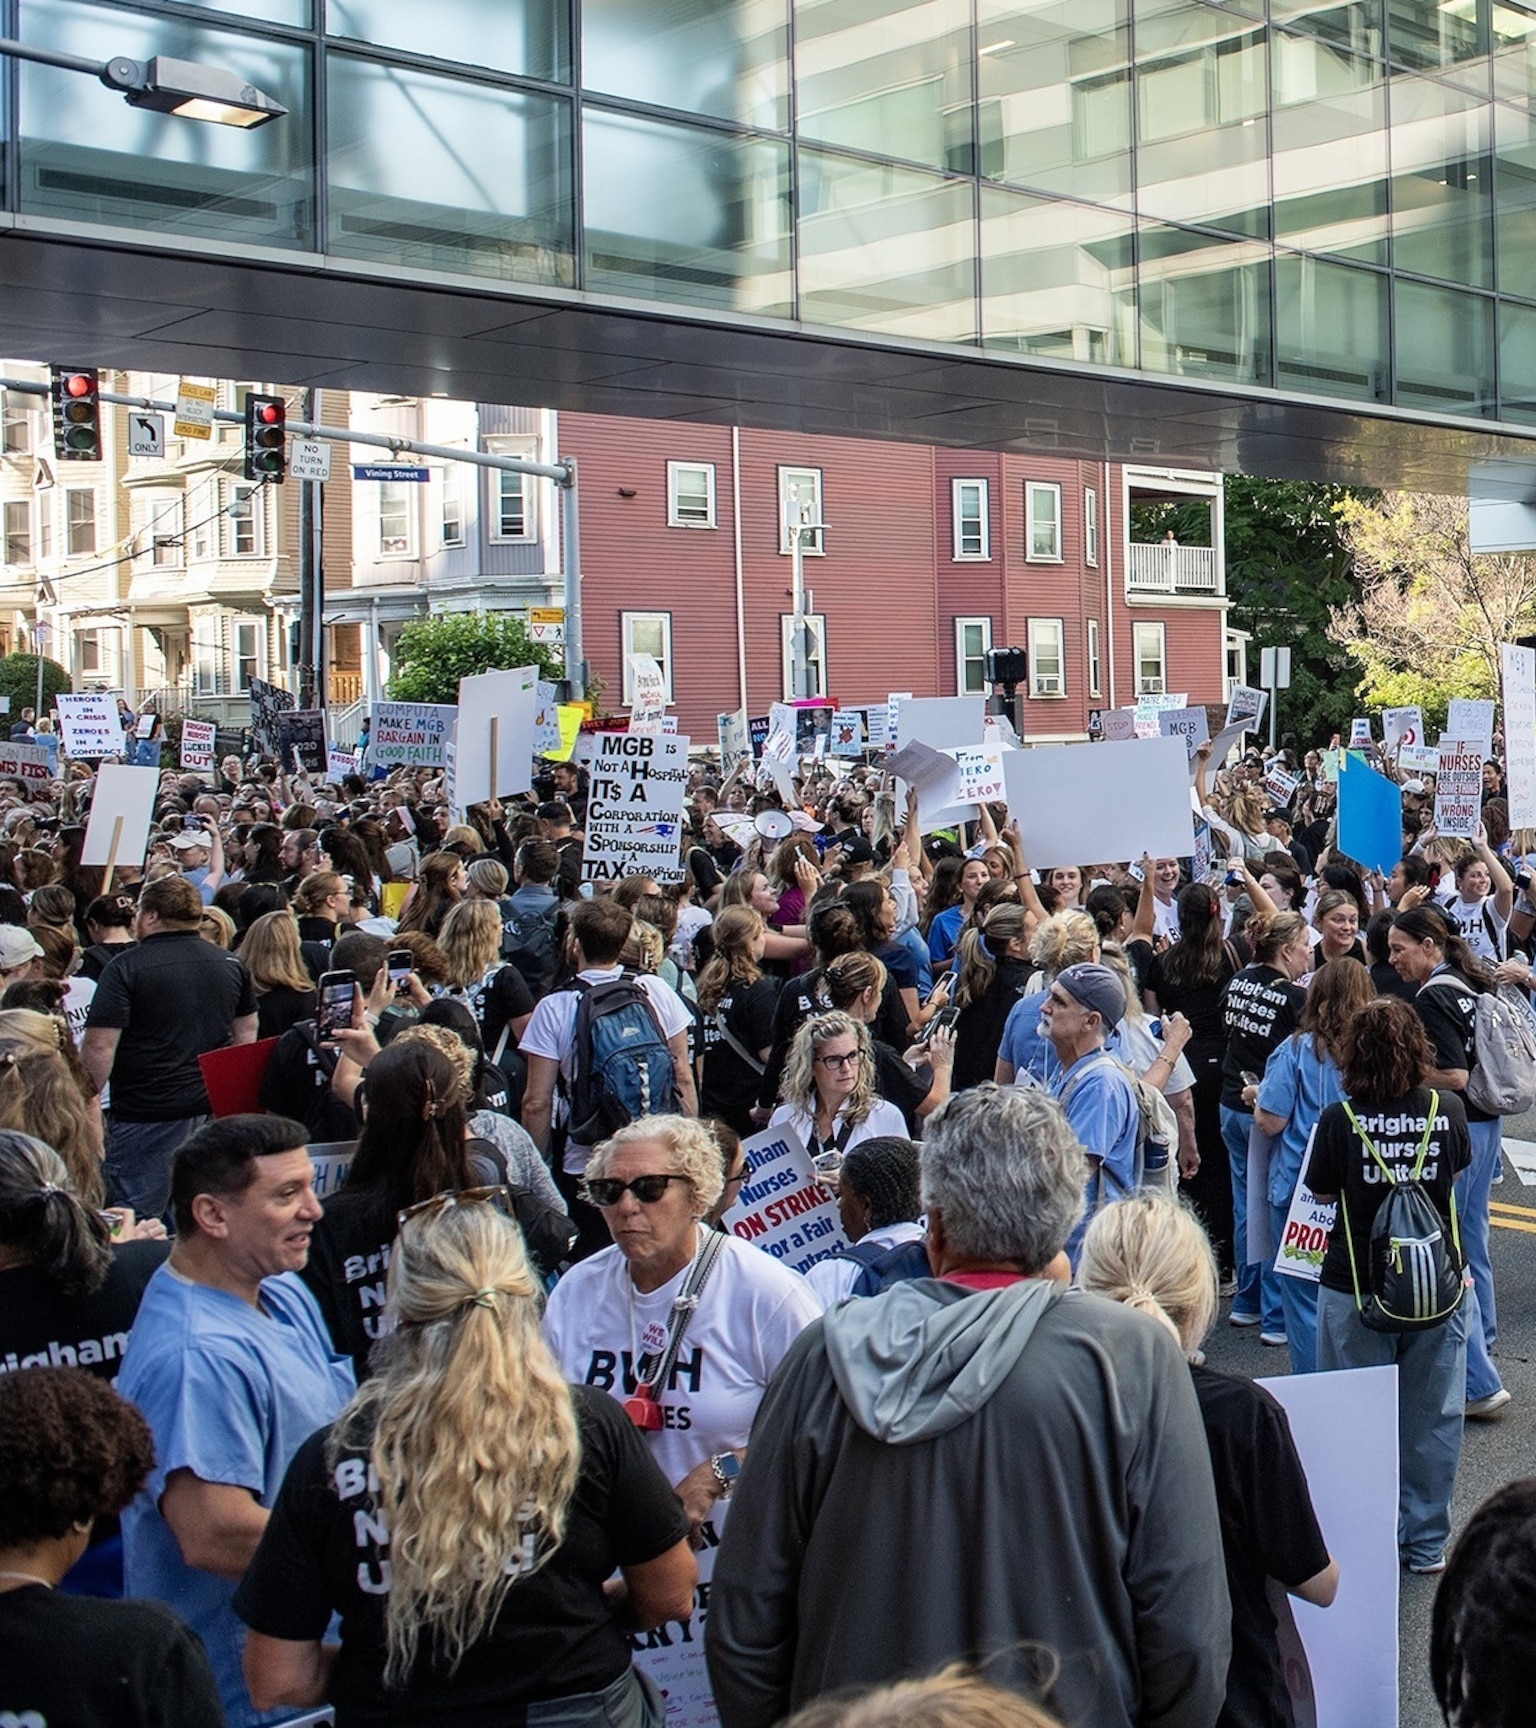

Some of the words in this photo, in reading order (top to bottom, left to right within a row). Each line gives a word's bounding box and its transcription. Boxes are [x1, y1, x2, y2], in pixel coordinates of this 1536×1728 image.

[135, 443, 159, 452] ONLY
[304, 445, 319, 453] NO
[299, 456, 323, 465] TURN
[293, 466, 307, 474] ON
[310, 467, 327, 476] RED
[365, 470, 392, 479] Vining
[377, 704, 439, 718] COMPUTA
[185, 722, 213, 733] BRIGHAM
[379, 718, 412, 730] MAKE
[416, 719, 445, 732] MGB
[1107, 722, 1129, 730] STOP
[1170, 722, 1197, 735] MGB
[187, 731, 210, 740] NURSES
[377, 730, 425, 744] BARGAIN
[429, 734, 440, 744] IN
[183, 743, 212, 751] LOCKED
[602, 736, 654, 756] MGB
[666, 744, 677, 754] IS
[1457, 741, 1465, 753] IF
[184, 754, 210, 766] OUT
[330, 753, 360, 767] NOBODY
[376, 746, 405, 758] GOOD
[408, 748, 442, 762] FAITH
[956, 752, 984, 762] From
[1439, 755, 1481, 771] NURSES
[595, 759, 619, 772] NOT
[621, 761, 629, 772] A
[631, 761, 688, 782] HOSPITAL
[1438, 772, 1450, 781] ARE
[1452, 772, 1480, 782] OUTSIDE
[629, 783, 647, 802] A
[1438, 783, 1479, 795] SOMETHING
[1441, 805, 1473, 817] WRONG
[589, 822, 619, 833] WITH
[624, 825, 633, 833] A
[1443, 817, 1469, 828] INSIDE
[588, 834, 677, 854] SPONSORSHIP
[583, 859, 627, 880] TAX
[1228, 978, 1288, 1006] Brigham
[1227, 994, 1277, 1020] Nurses
[1352, 1113, 1449, 1136] Brigham
[1361, 1139, 1440, 1158] Nurses
[738, 1167, 798, 1207] Nurses
[733, 1212, 768, 1241] ON
[764, 1183, 832, 1227] STRIKE
[761, 1237, 791, 1258] for
[790, 1232, 803, 1249] a
[801, 1216, 836, 1243] Fair
[649, 1324, 665, 1337] WE
[642, 1332, 664, 1348] WILL
